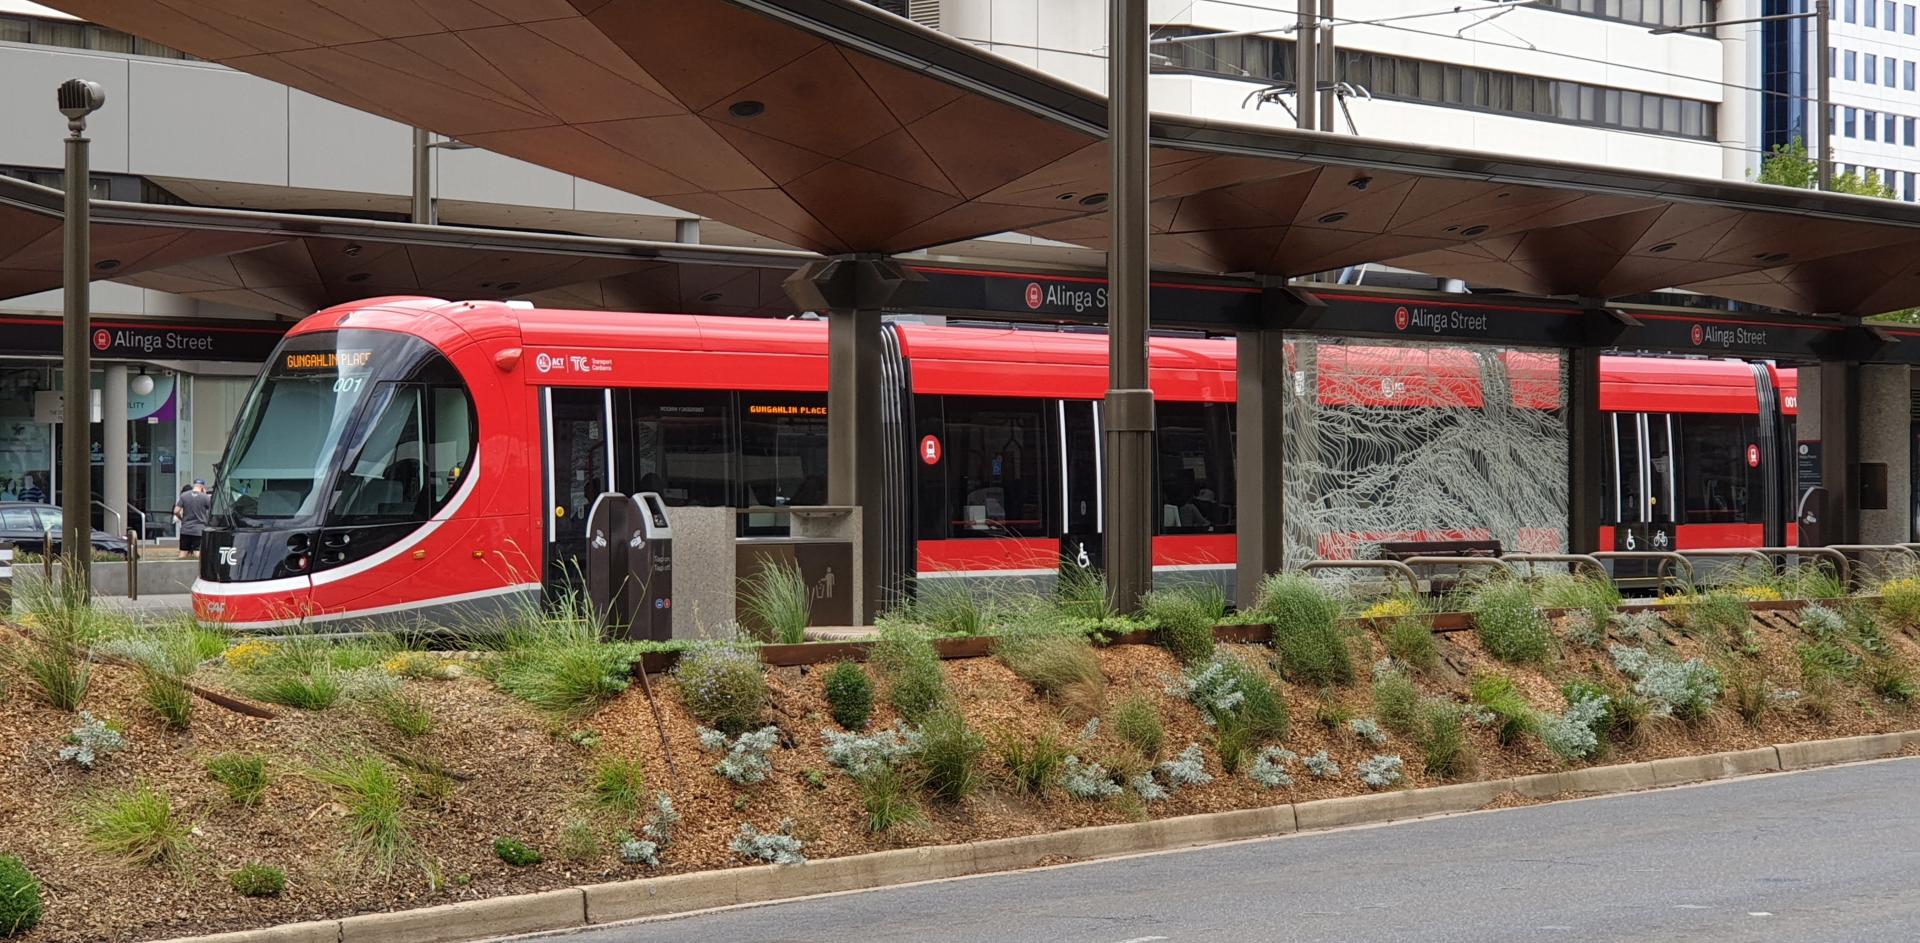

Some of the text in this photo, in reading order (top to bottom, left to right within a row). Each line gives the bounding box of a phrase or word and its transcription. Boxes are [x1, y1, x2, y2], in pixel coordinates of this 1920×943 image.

[1046, 285, 1092, 312] Alinga
[1411, 309, 1487, 333] Alinga Street
[114, 331, 213, 353] Alinga Street
[1705, 326, 1766, 348] Alinga Street
[287, 354, 339, 368] GUNGAHLIN
[552, 357, 564, 365] ACT
[570, 356, 590, 372] TC
[333, 377, 363, 393] 001
[750, 405, 827, 415] GUNGAHLIN PLACE
[1784, 396, 1798, 408] 001
[219, 546, 237, 565] TC
